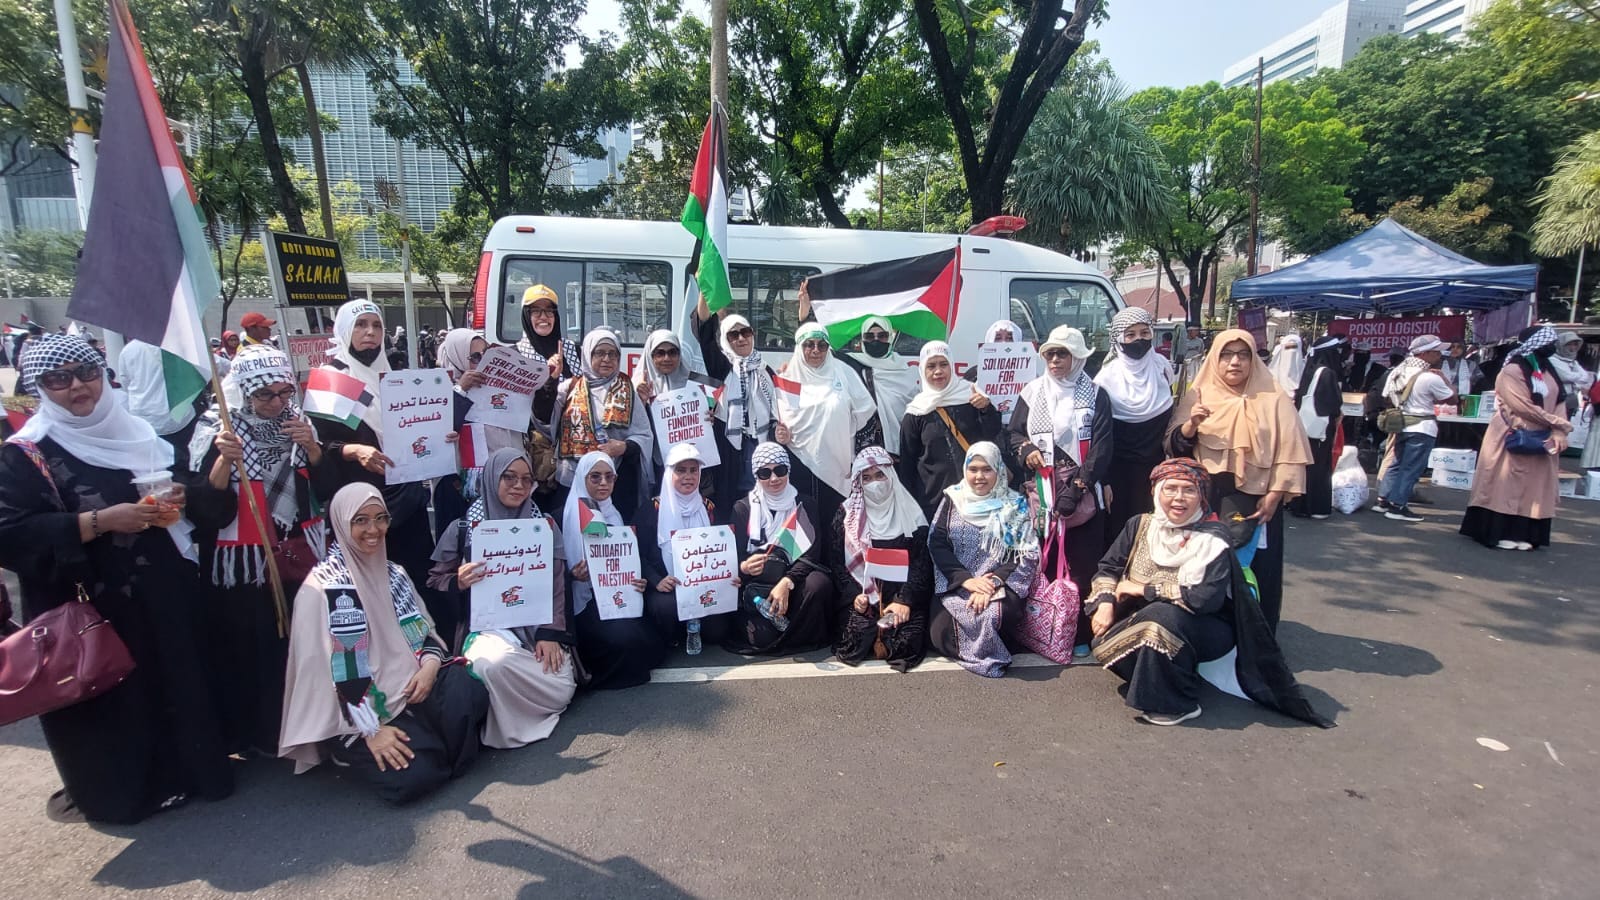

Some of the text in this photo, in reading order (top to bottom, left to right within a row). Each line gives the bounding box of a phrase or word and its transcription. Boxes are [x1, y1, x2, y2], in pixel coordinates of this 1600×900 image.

[285, 263, 341, 284] SALMAN
[1348, 320, 1441, 336] POSKO LOGISTIK
[1362, 335, 1415, 349] KEBERSI
[482, 365, 497, 375] KE
[489, 356, 541, 381] SERET ISRAEL
[982, 357, 1031, 370] SOLIDARITY
[998, 370, 1015, 383] FOR
[388, 396, 448, 412] وعدنا تحرير
[680, 399, 700, 415] STOP
[398, 411, 442, 429] فلسطين
[667, 412, 700, 431] FUNDING
[668, 424, 705, 444] GENOCIDE
[482, 544, 542, 560] إندونيسيا
[589, 542, 633, 558] SOLIDARITY
[681, 543, 727, 560] التضامن
[528, 560, 547, 571] ضد
[605, 558, 620, 572] FOR
[685, 555, 727, 573] من أجل
[598, 571, 636, 587] PALESTINE
[683, 569, 732, 587] فلسطين
